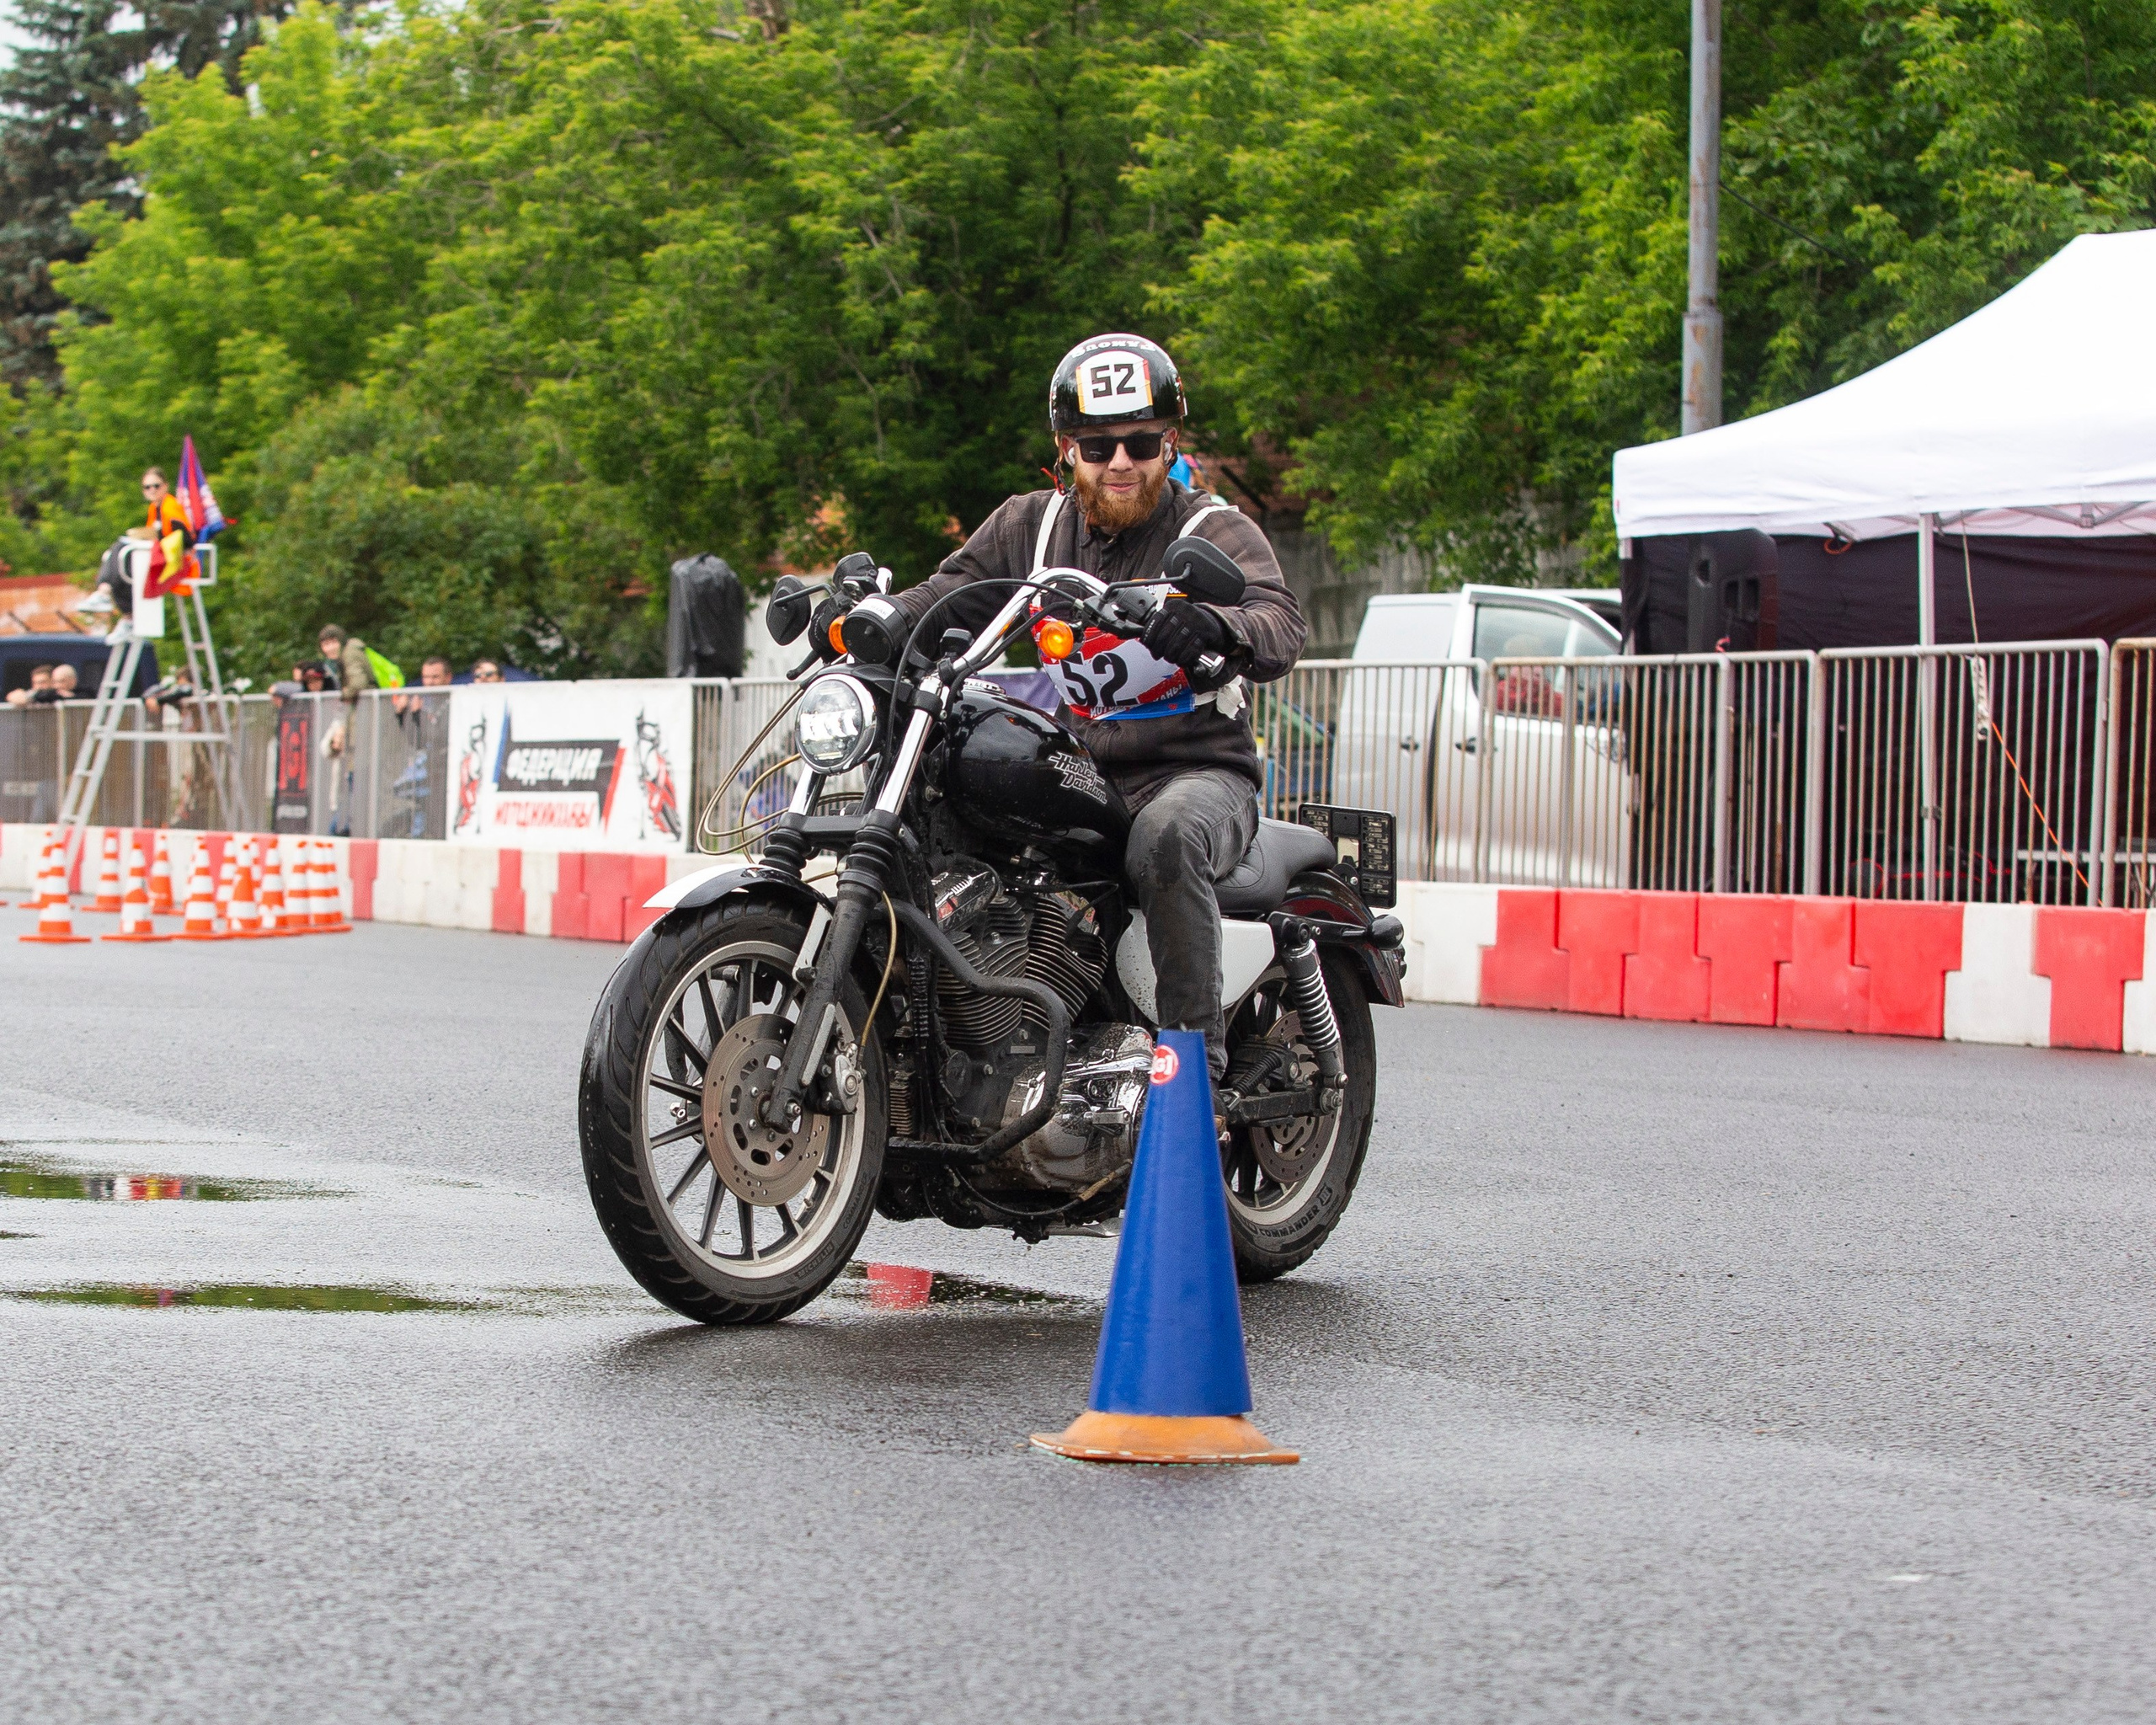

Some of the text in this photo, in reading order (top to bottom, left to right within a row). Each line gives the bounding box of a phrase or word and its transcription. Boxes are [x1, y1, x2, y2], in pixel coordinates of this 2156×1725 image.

[1090, 363, 1136, 398] 52
[1060, 652, 1137, 707] 52
[1049, 750, 1105, 785] Harley
[1060, 772, 1107, 804] Davidson
[1260, 1205, 1320, 1237] COMMANDER
[798, 1243, 833, 1277] MICHELIN
